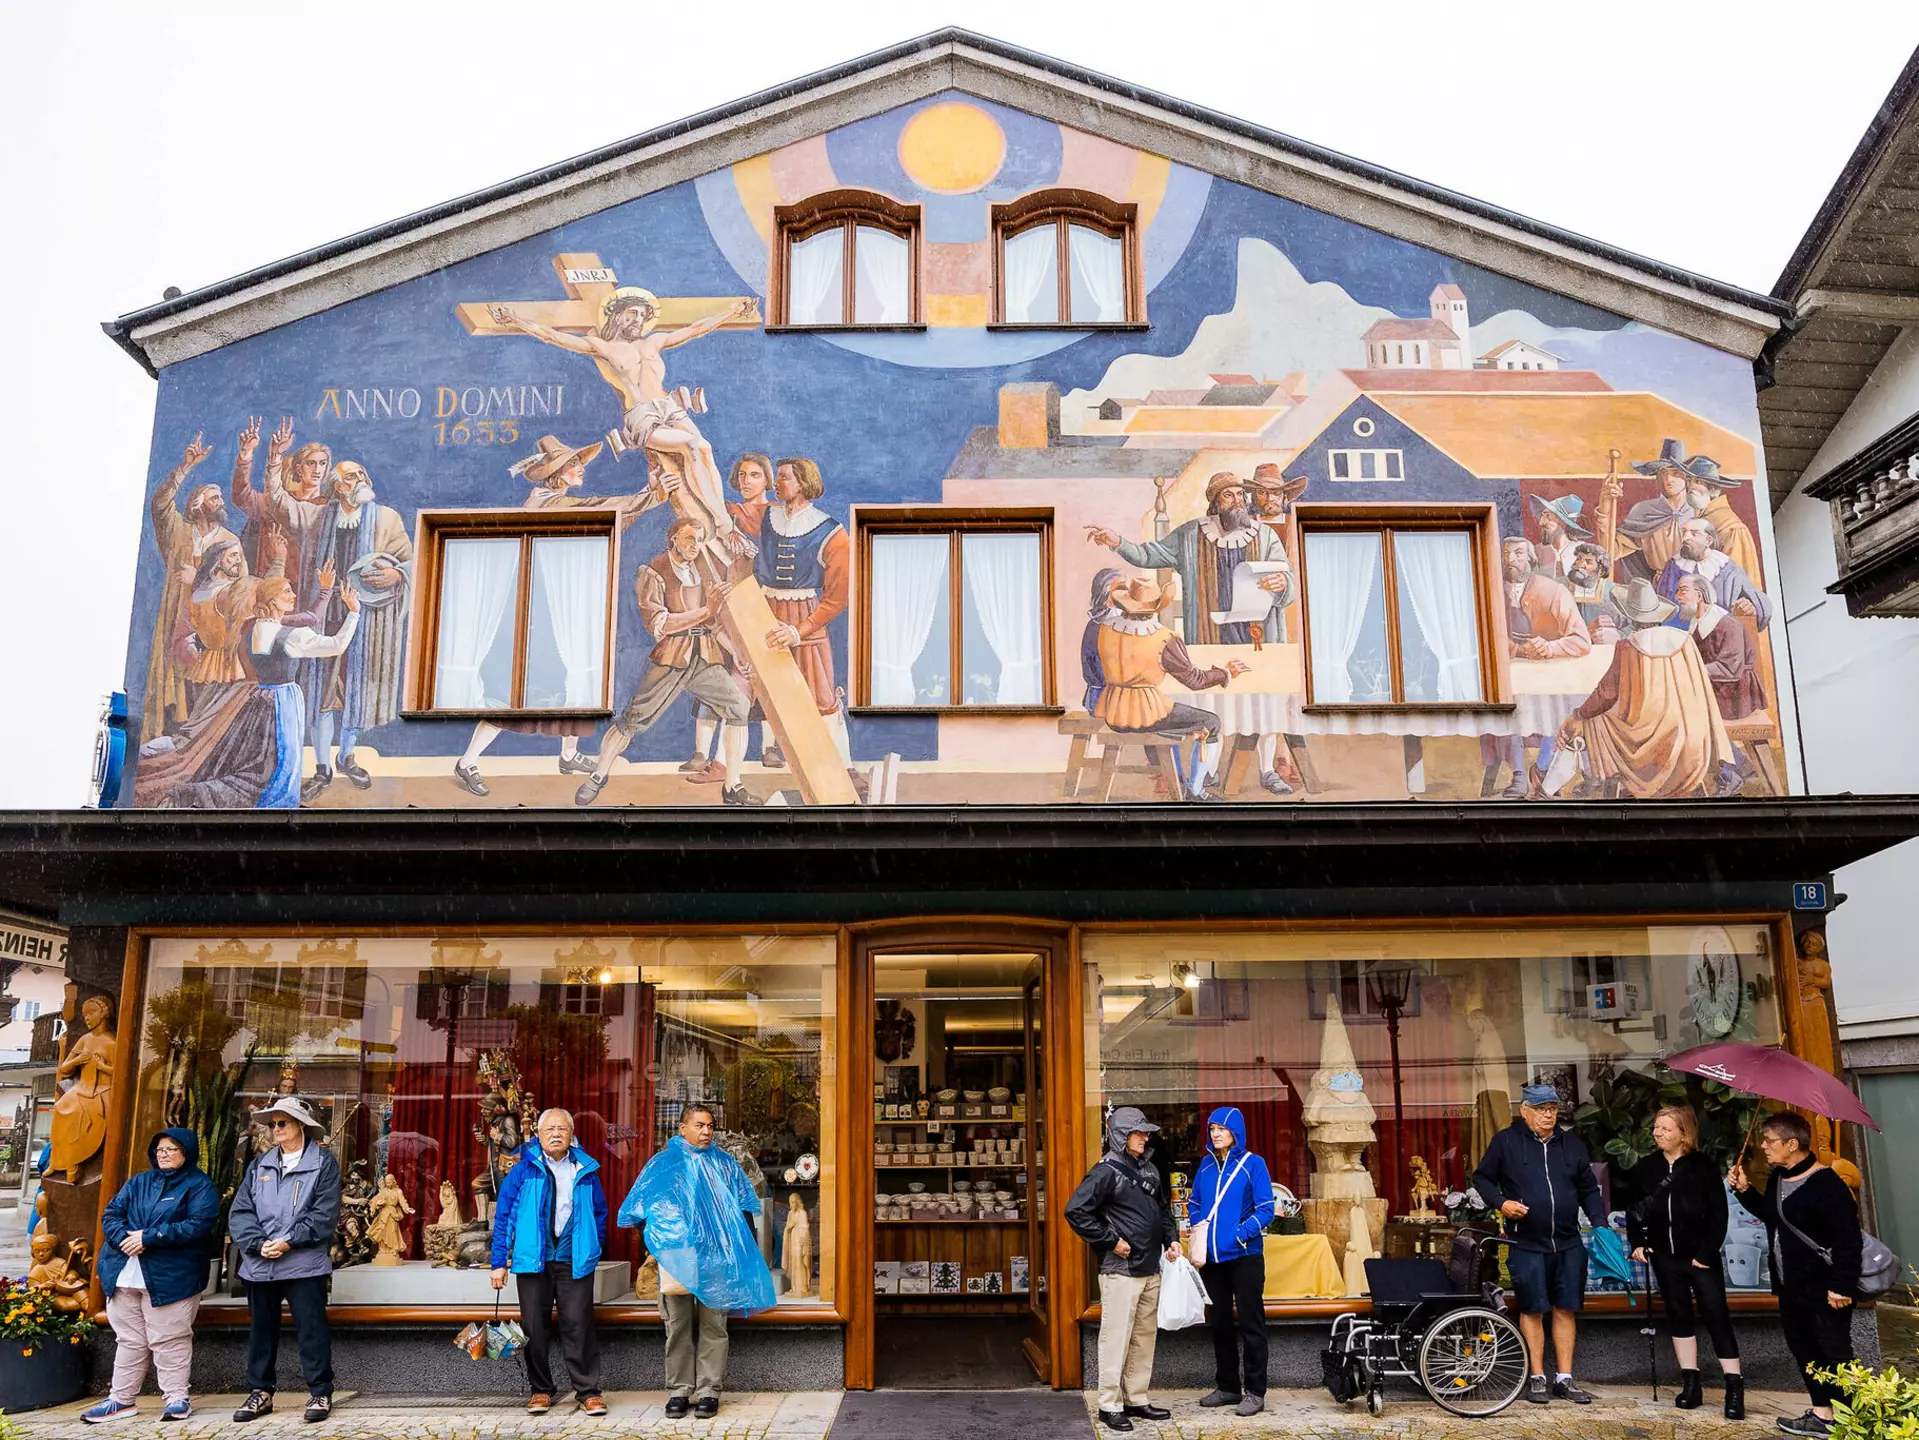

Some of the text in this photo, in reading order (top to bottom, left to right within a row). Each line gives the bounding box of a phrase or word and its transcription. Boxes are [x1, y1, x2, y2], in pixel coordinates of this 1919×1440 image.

[315, 385, 564, 419] ANNO DOMINI
[1801, 886, 1817, 900] 18
